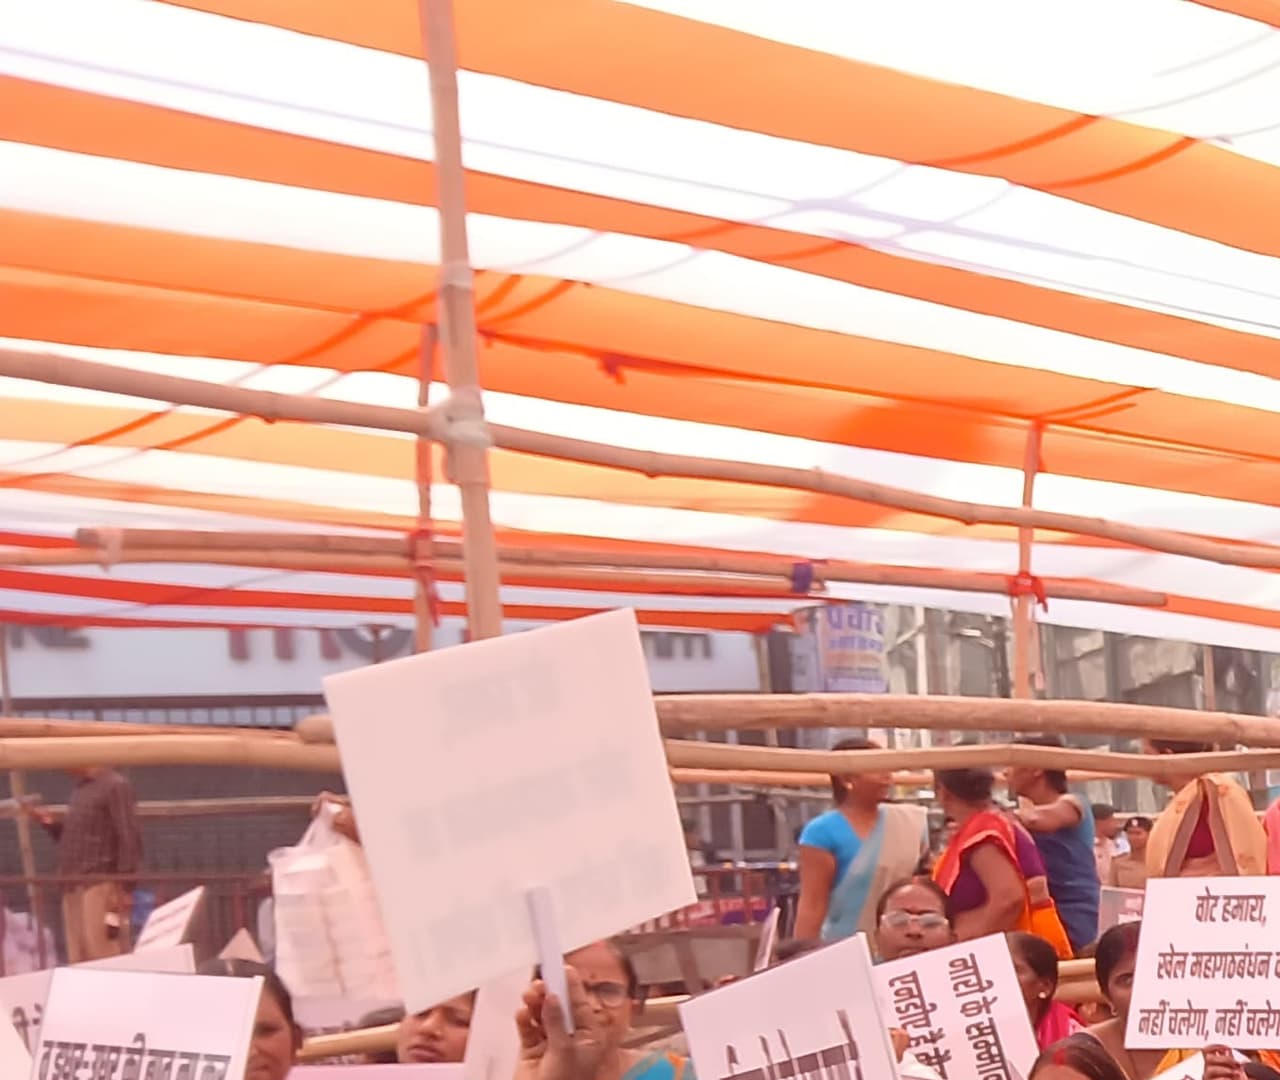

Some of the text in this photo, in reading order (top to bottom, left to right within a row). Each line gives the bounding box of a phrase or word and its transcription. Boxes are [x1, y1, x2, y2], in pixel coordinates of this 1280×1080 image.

[1196, 886, 1266, 927] वोट हमारा,
[949, 953, 994, 997] नारी
[1157, 943, 1189, 979] खेल
[1190, 943, 1272, 979] महागठबंधन
[889, 970, 937, 1031] एनडीए
[960, 996, 997, 1017] के
[1138, 999, 1170, 1036] नहीं
[1169, 999, 1209, 1041] चलेगा,
[1215, 999, 1248, 1036] नहीं
